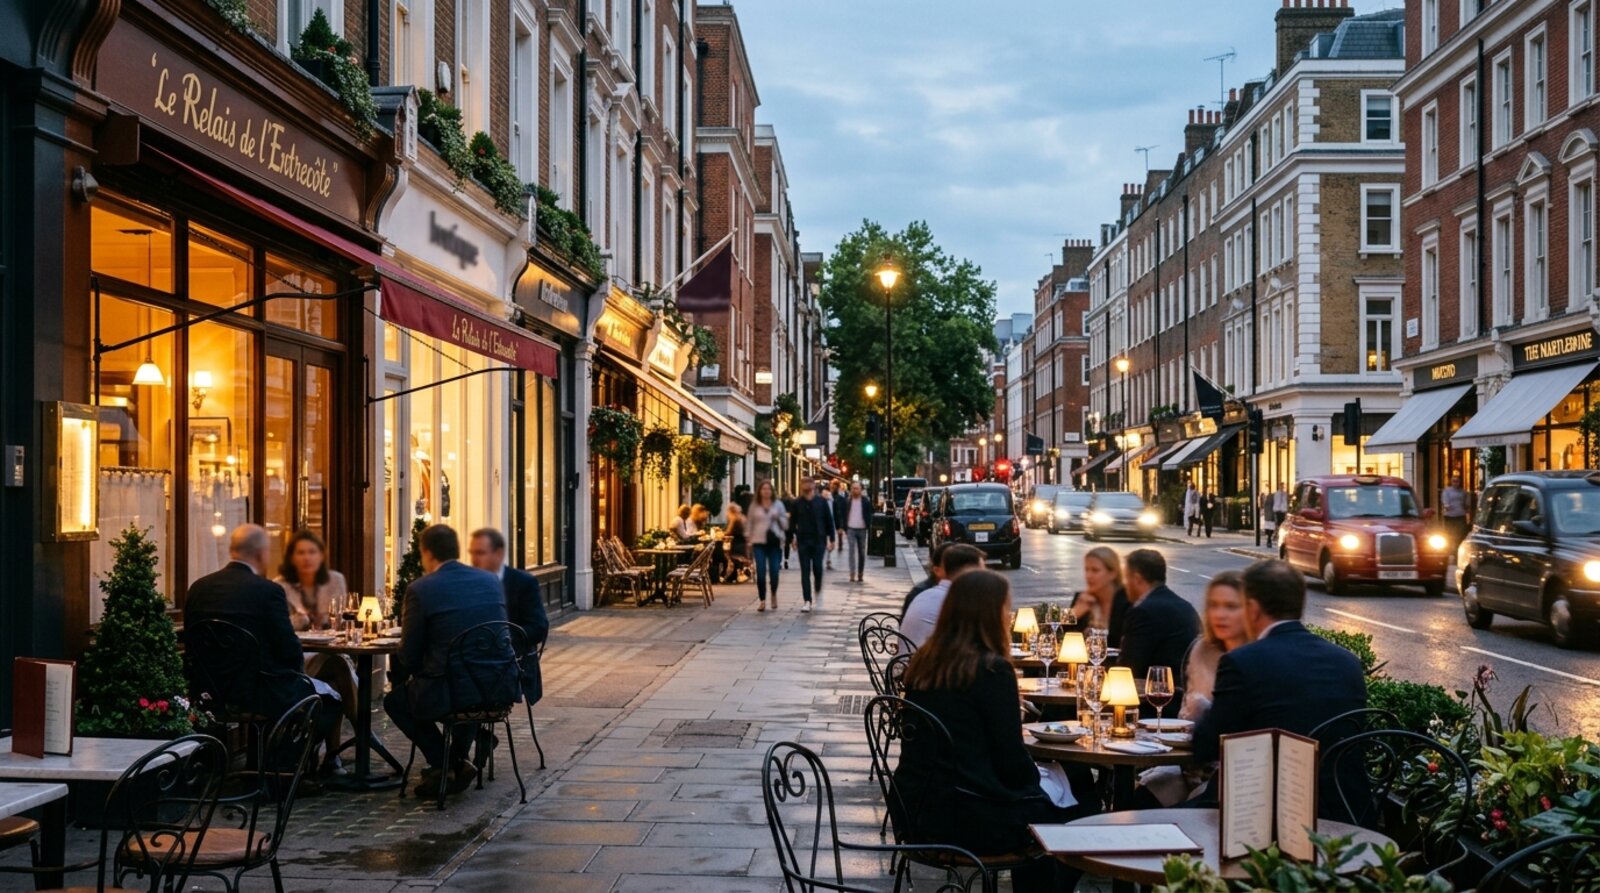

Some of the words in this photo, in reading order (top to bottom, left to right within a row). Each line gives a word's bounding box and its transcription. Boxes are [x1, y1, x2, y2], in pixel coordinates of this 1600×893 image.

[182, 73, 236, 148] Relais
[240, 119, 255, 158] de
[1524, 344, 1540, 361] THE
